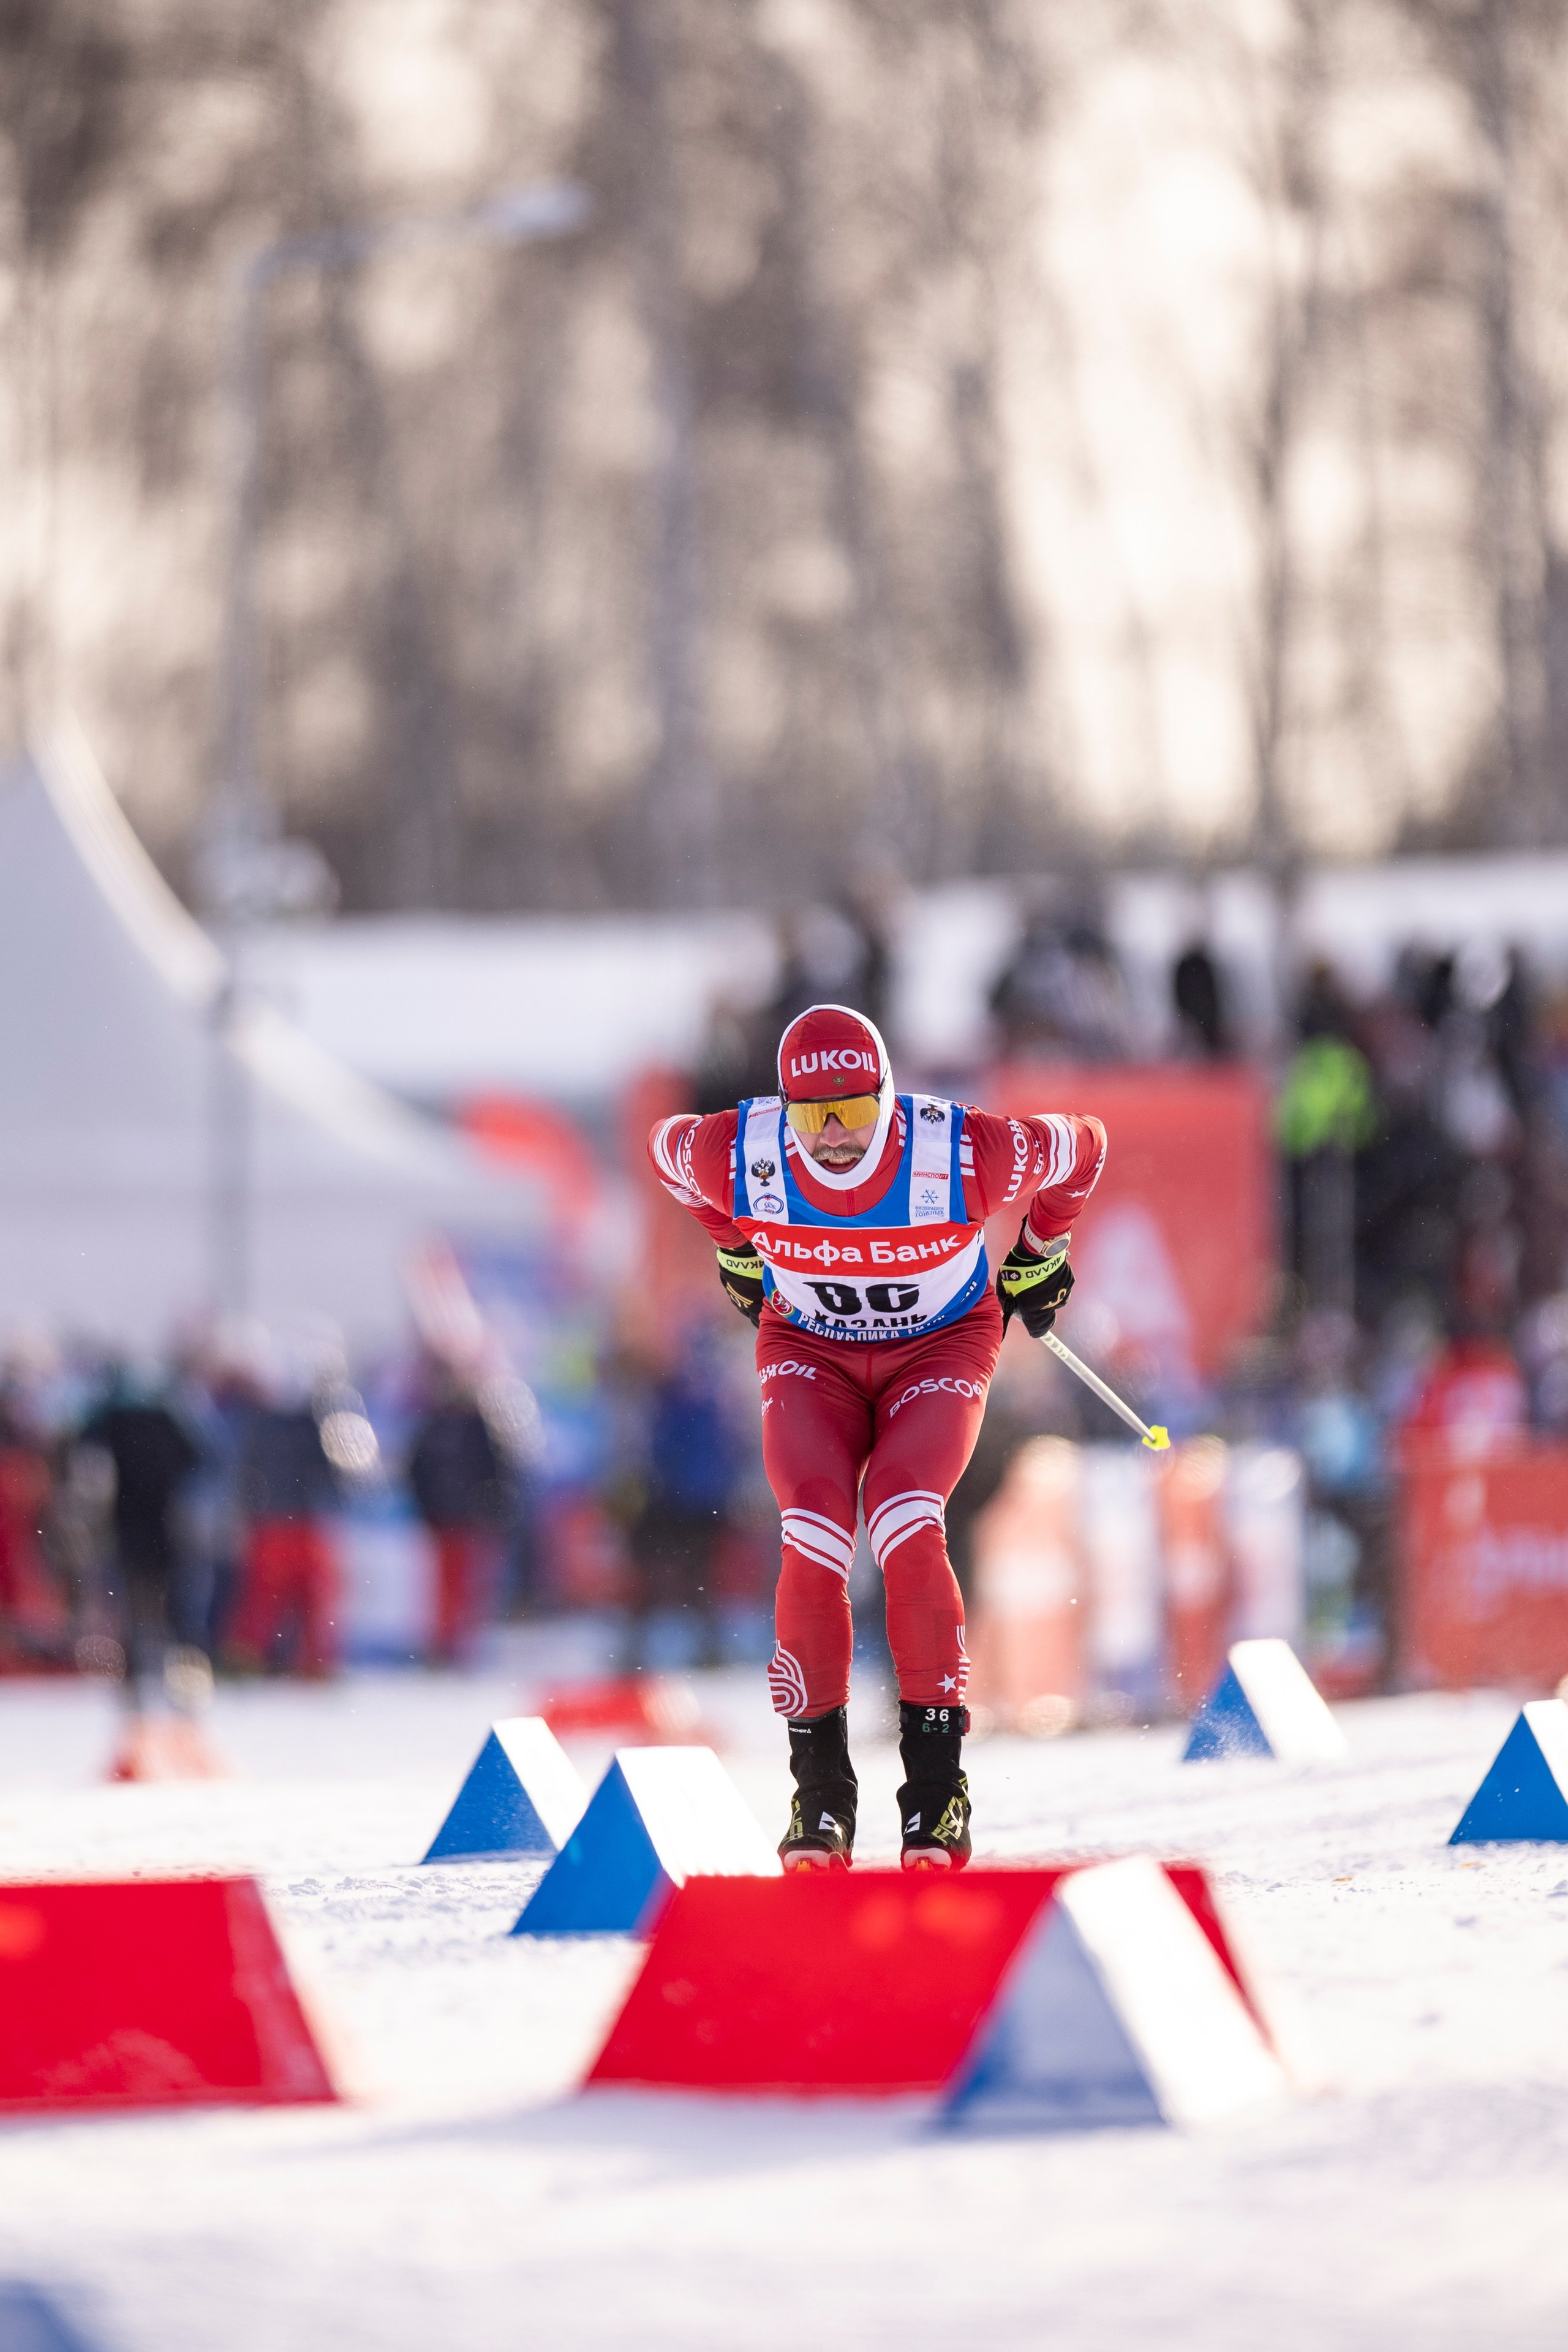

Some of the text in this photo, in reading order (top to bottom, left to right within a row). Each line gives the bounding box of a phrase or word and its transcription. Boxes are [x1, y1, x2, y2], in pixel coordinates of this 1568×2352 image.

[791, 1049, 876, 1077] LUKOIL
[913, 1171, 948, 1180] МИНСПОРТ
[751, 1232, 962, 1267] Альфа Банк
[889, 1378, 974, 1419] BOSCO
[925, 1708, 949, 1722] 36
